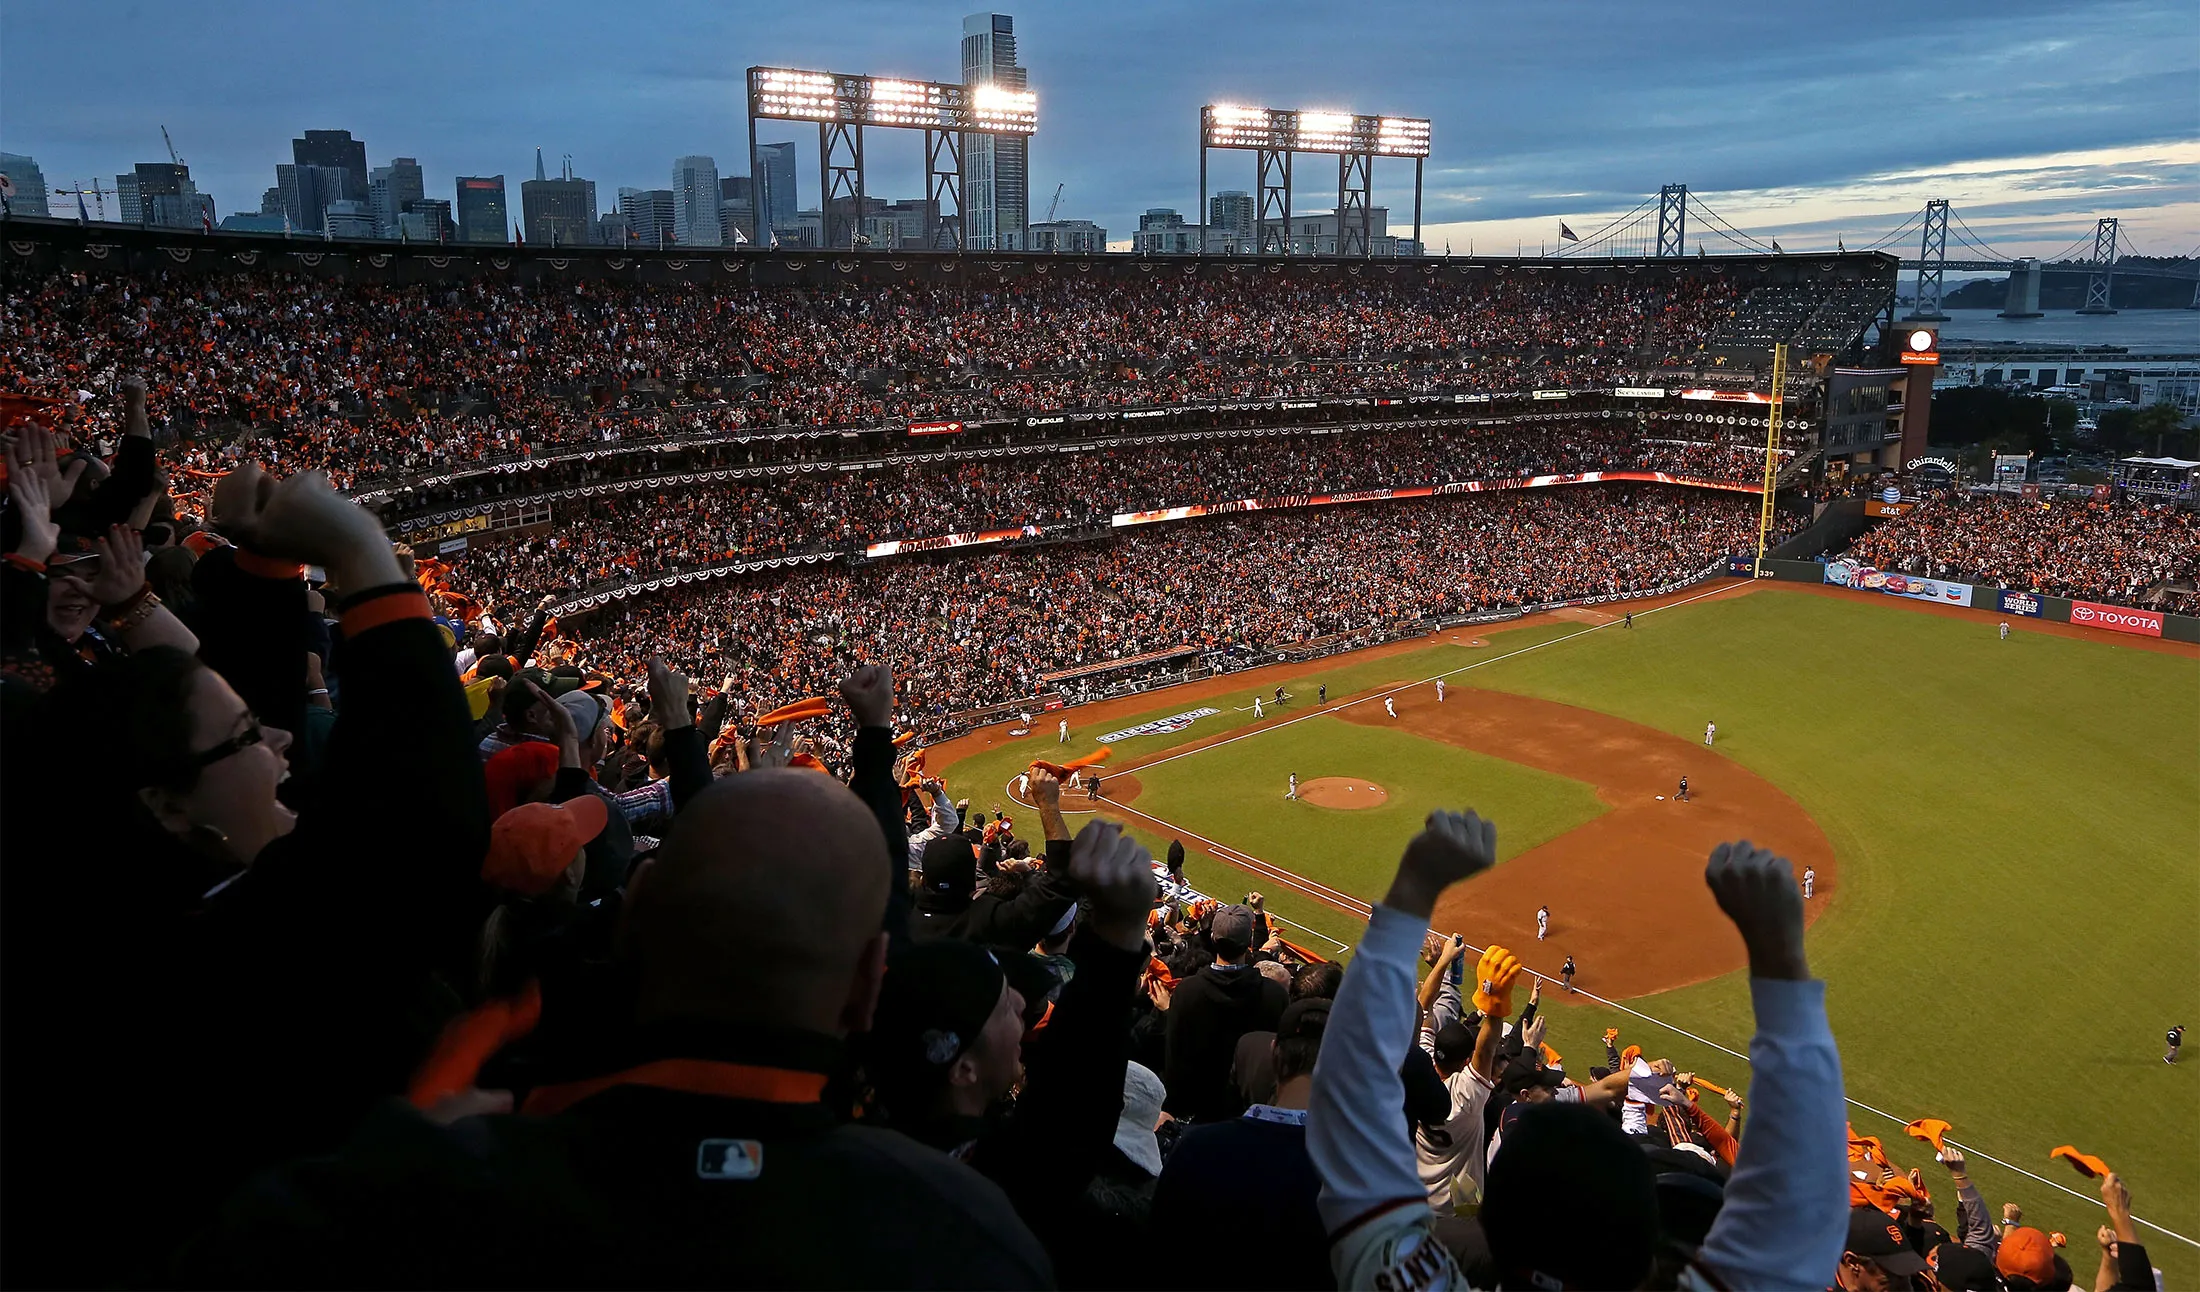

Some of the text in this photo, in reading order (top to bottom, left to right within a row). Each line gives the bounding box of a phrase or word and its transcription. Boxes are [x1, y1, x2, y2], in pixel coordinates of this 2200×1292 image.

[1037, 416, 1064, 425] LEXUS
[1906, 455, 1958, 474] Ghirardelli
[1329, 489, 1395, 503] PANDAMONIUM
[1880, 505, 1901, 516] at&t
[1759, 570, 1775, 578] 339
[2003, 602, 2038, 614] SERIES
[2004, 596, 2039, 608] WORLD
[2097, 611, 2161, 630] TOYOTA
[1886, 1225, 1903, 1241] SF
[1372, 1233, 1449, 1292] IANTS
